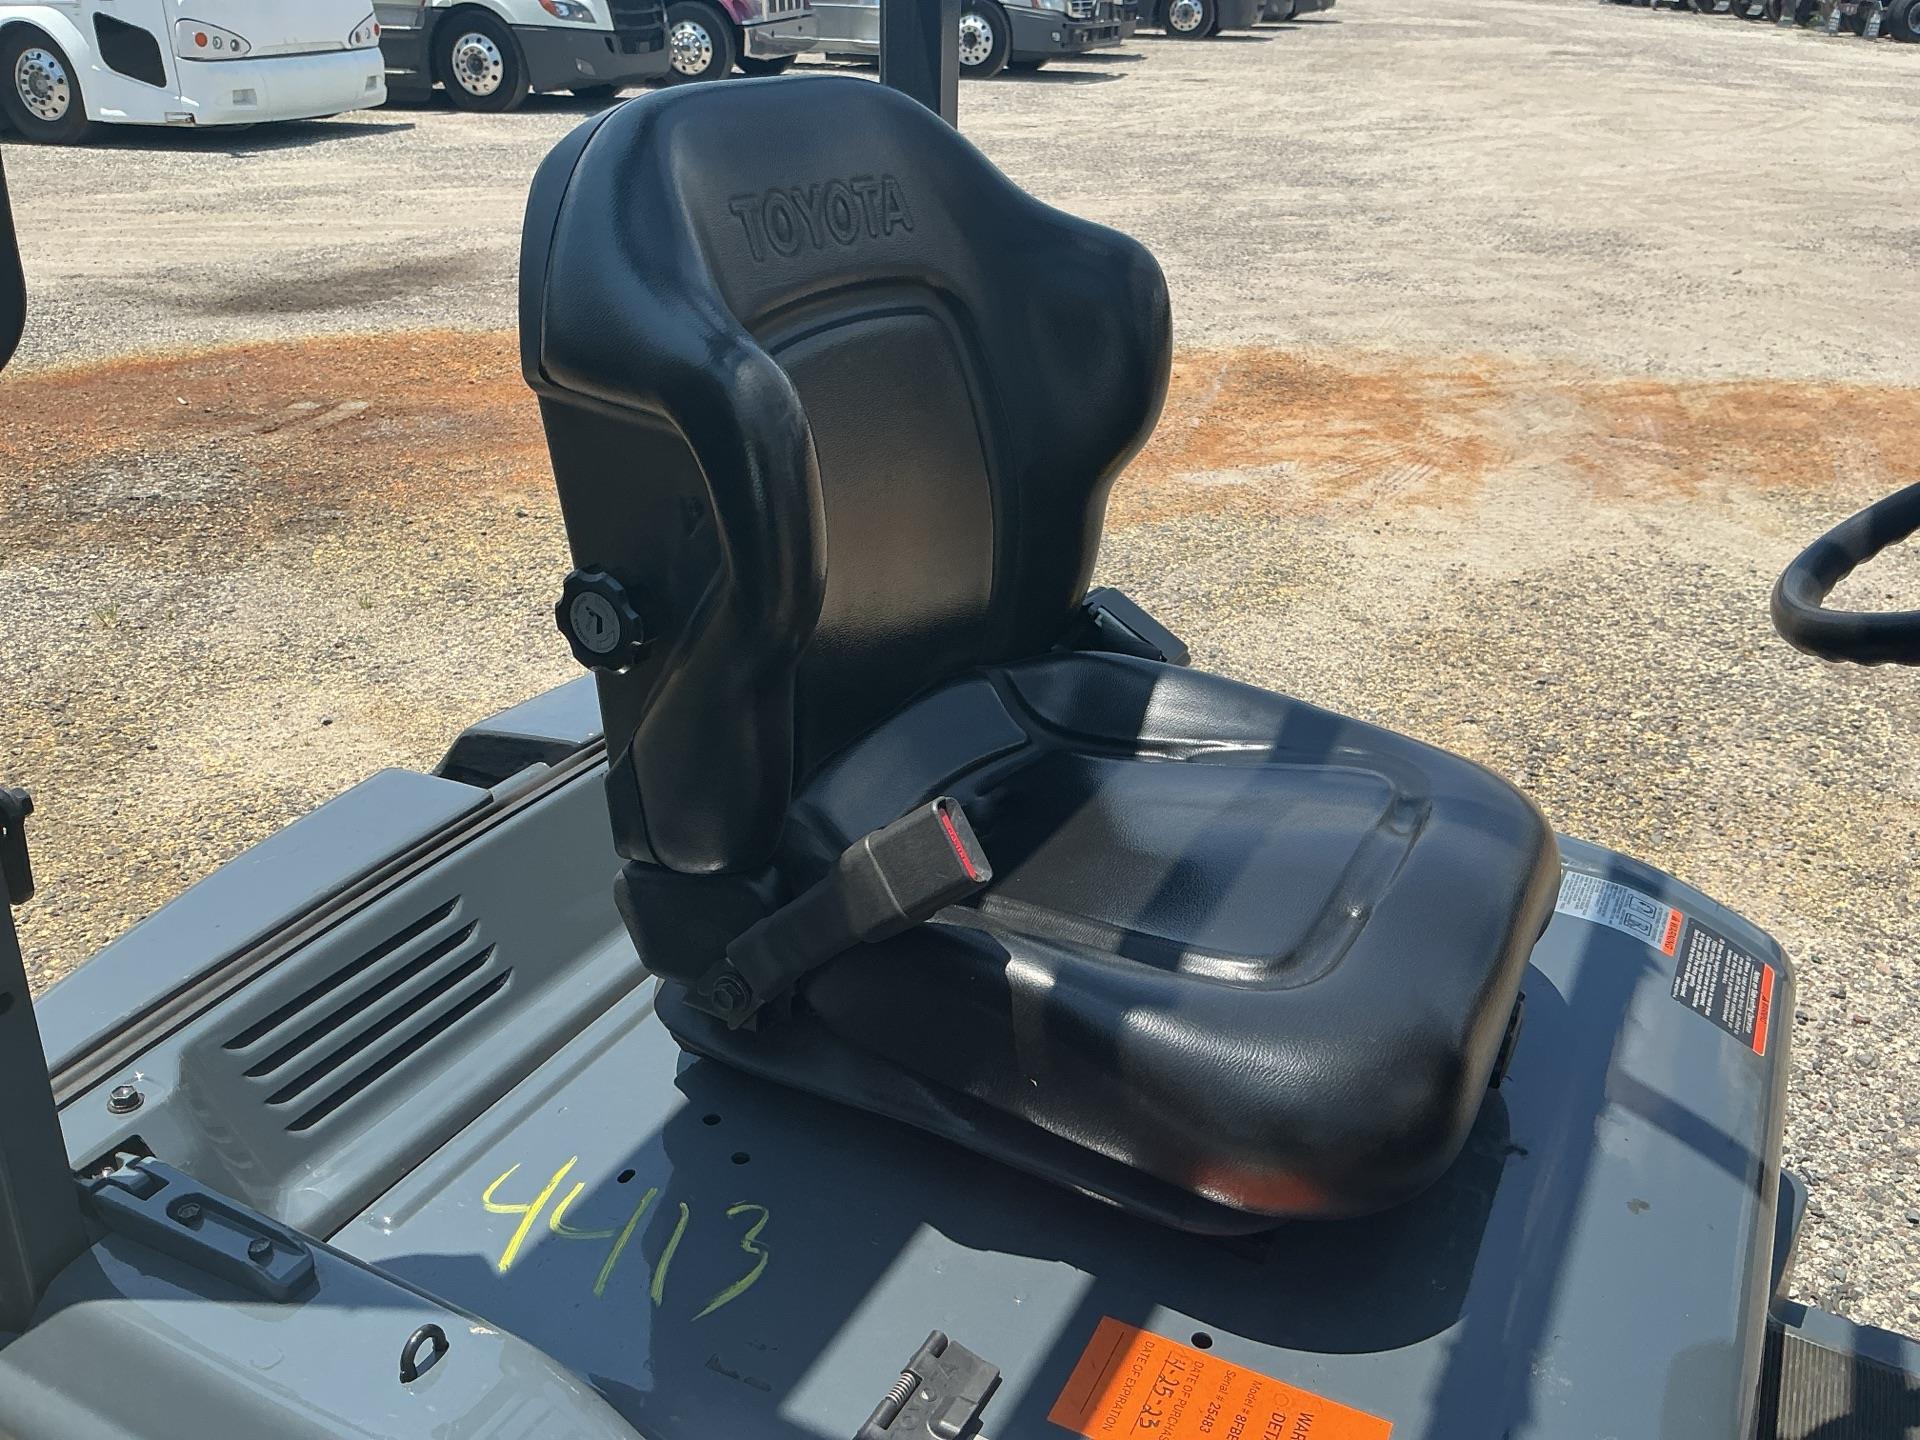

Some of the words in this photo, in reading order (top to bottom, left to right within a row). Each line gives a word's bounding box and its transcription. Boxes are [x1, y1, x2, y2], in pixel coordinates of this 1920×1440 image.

[728, 173, 915, 263] TOYOTA
[1664, 921, 1681, 950] WARNING
[482, 1155, 770, 1322] 4413
[1141, 1341, 1156, 1364] DATE
[1132, 1364, 1143, 1378] OF
[1191, 1361, 1205, 1384] DATE
[1220, 1370, 1237, 1396] Serial
[1102, 1377, 1136, 1432] EXPIRATION
[1184, 1384, 1194, 1399] OF
[1248, 1380, 1264, 1408] Model
[1199, 1402, 1221, 1433] 25483
[1263, 1412, 1286, 1440] DET
